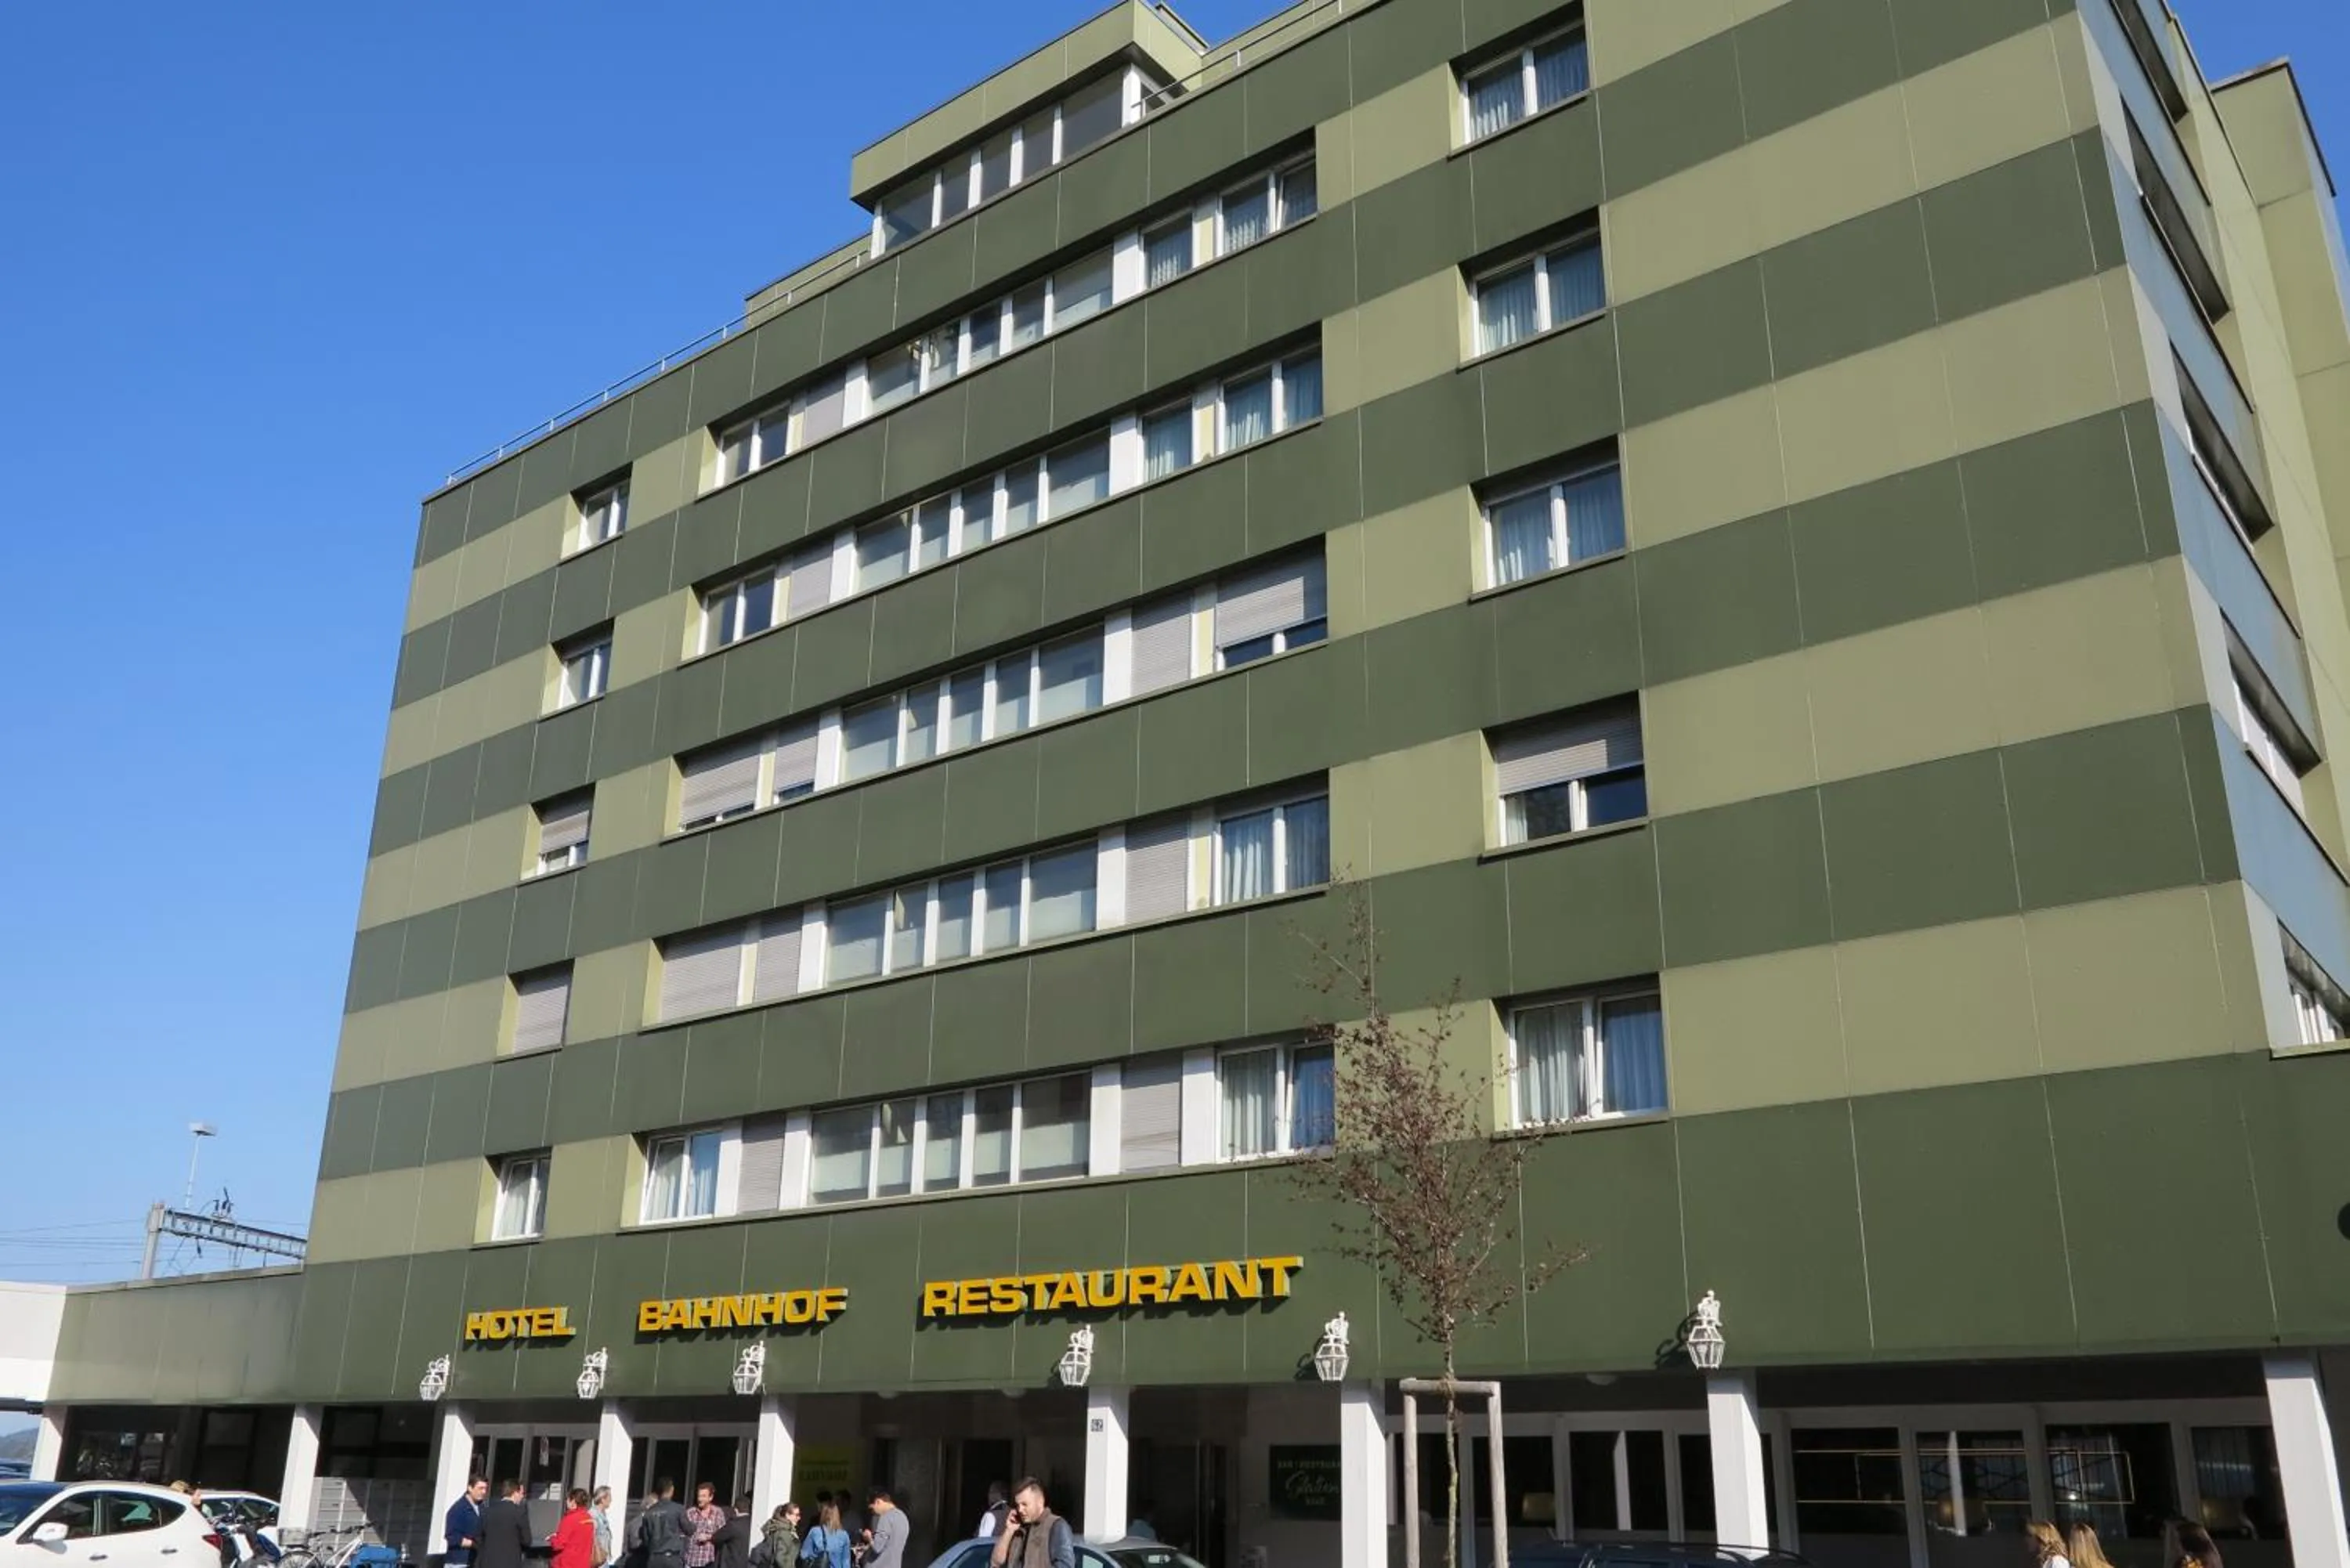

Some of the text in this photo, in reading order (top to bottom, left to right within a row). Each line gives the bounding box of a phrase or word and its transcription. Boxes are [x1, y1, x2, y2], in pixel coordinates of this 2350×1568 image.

[465, 1256, 1303, 1340] HOTEL BAHNHOF RESTAURANT
